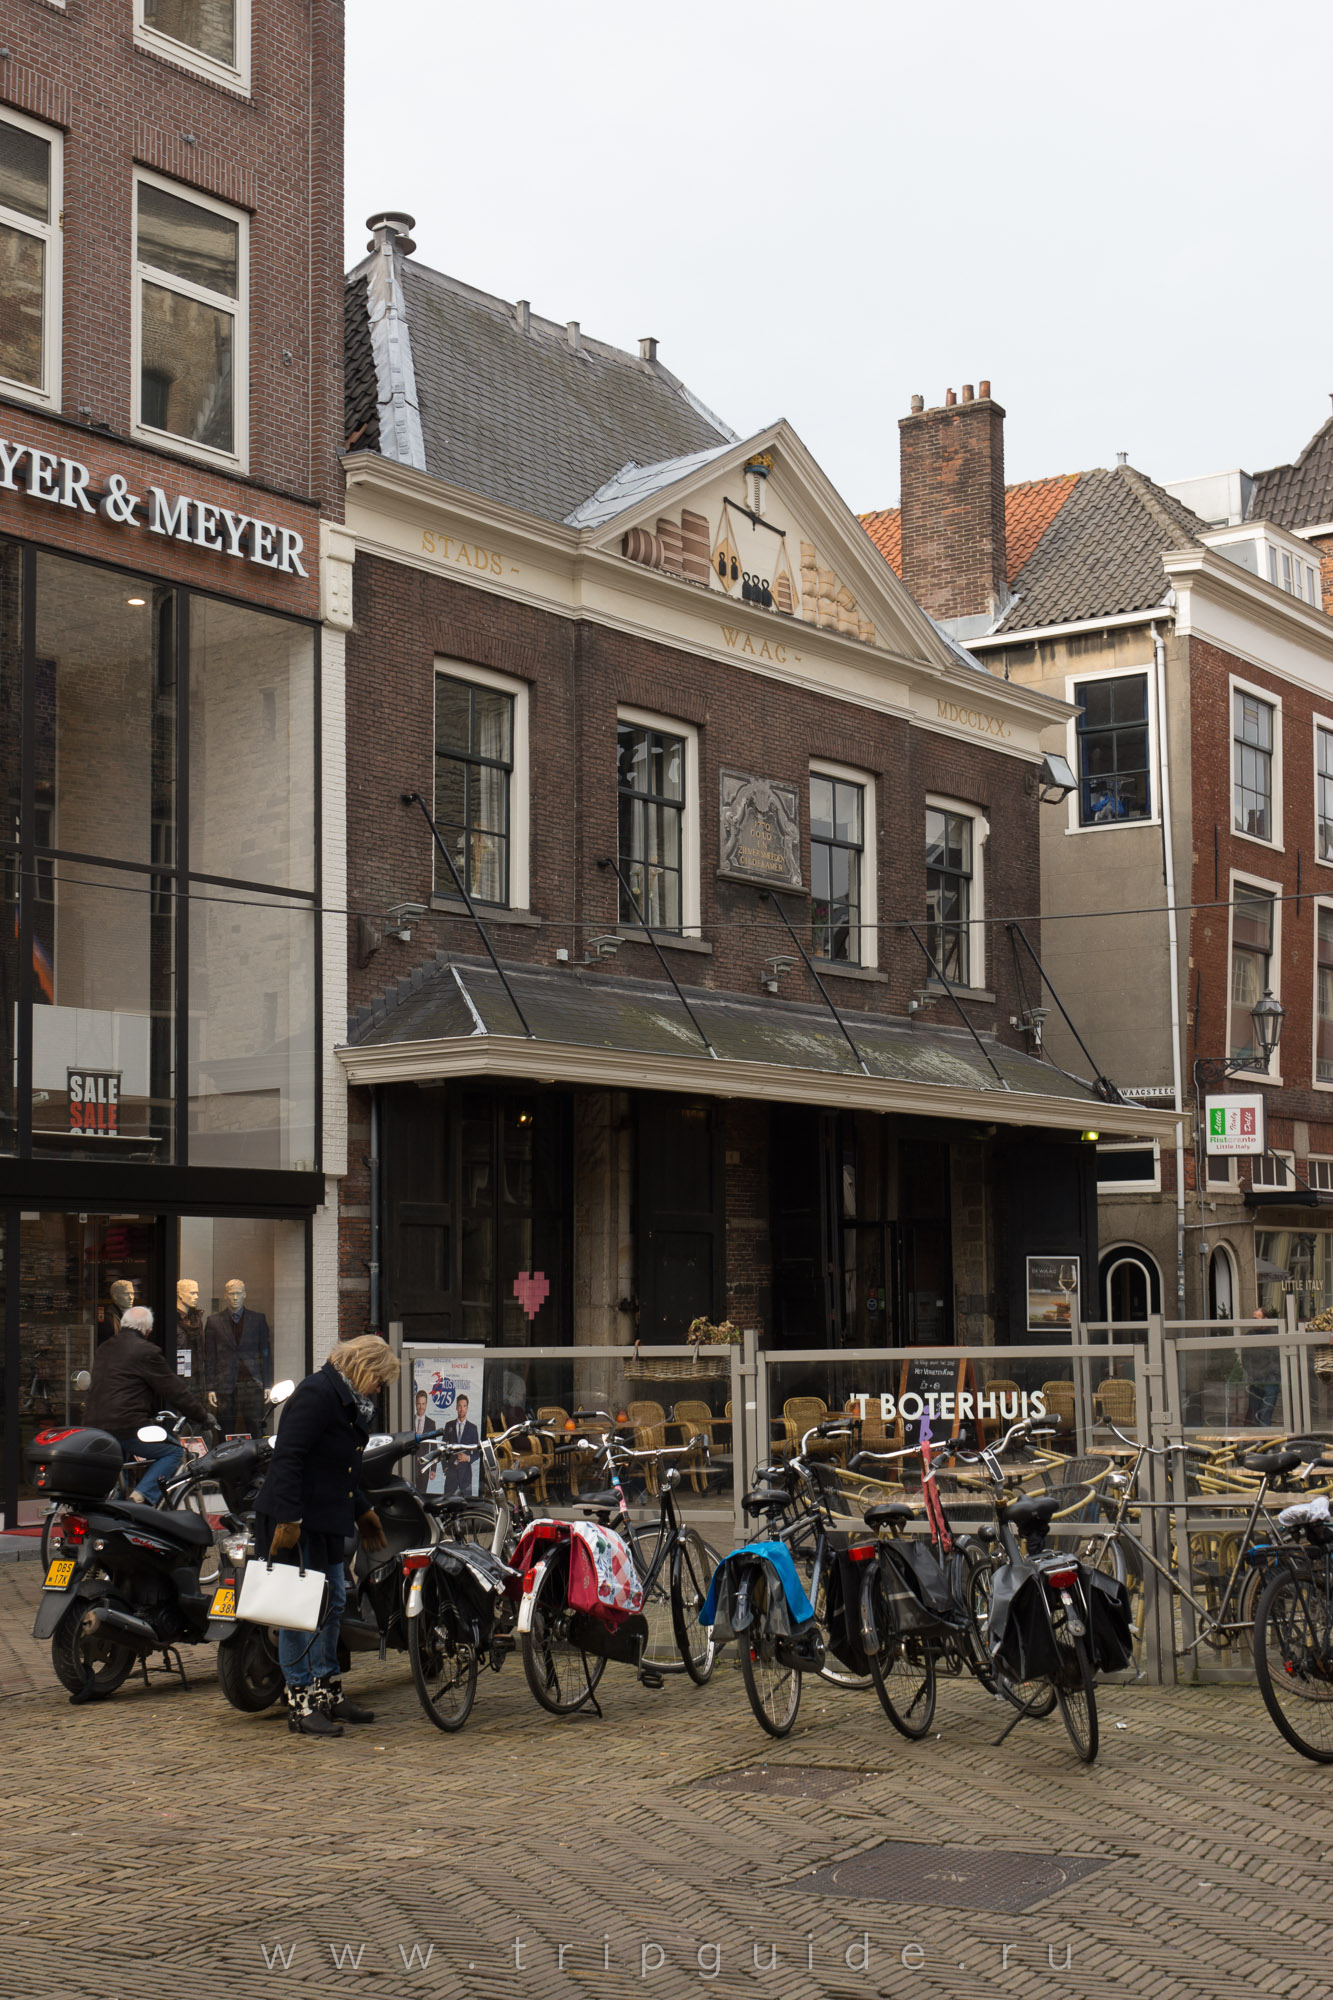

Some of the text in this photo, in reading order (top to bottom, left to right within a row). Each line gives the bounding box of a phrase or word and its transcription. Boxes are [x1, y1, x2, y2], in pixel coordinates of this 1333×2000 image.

[103, 473, 141, 527] &
[148, 485, 309, 578] MEYER
[70, 1075, 118, 1104] SALE
[1120, 1088, 1175, 1097] WAAGSTEEG
[70, 1102, 118, 1129] SALE
[1213, 1110, 1222, 1134] Little
[1229, 1111, 1238, 1131] Italy
[1243, 1111, 1253, 1132] Delft
[1281, 1280, 1324, 1291] LITTLE ITALY
[434, 1391, 452, 1406] 275
[880, 1391, 1047, 1421] BOTERHUIS
[57, 1562, 73, 1573] DBS
[54, 1574, 68, 1585] 17K
